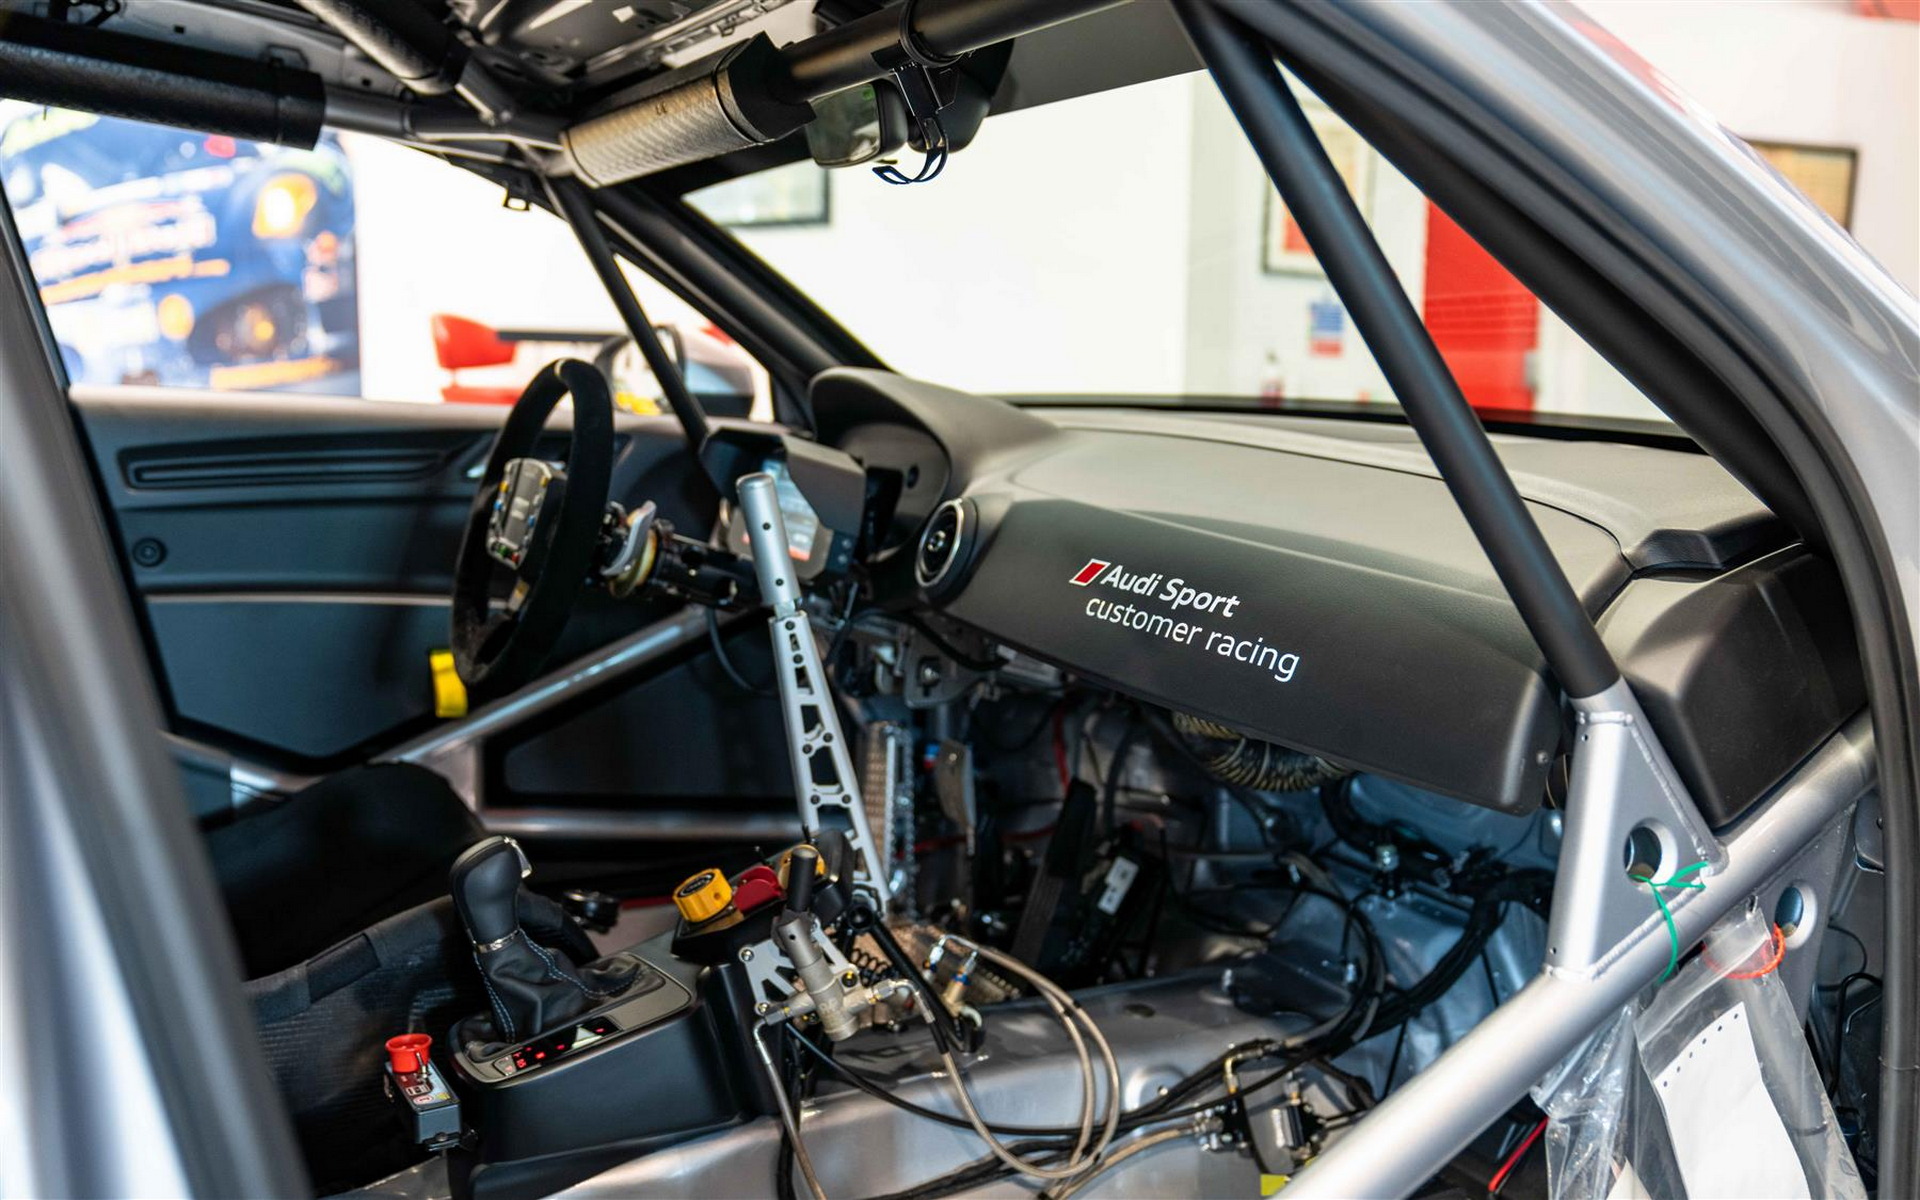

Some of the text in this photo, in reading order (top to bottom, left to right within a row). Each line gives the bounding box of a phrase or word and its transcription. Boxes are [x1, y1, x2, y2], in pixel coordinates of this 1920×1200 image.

[1100, 565, 1240, 618] Audi Sport
[1085, 597, 1300, 683] customer racing
